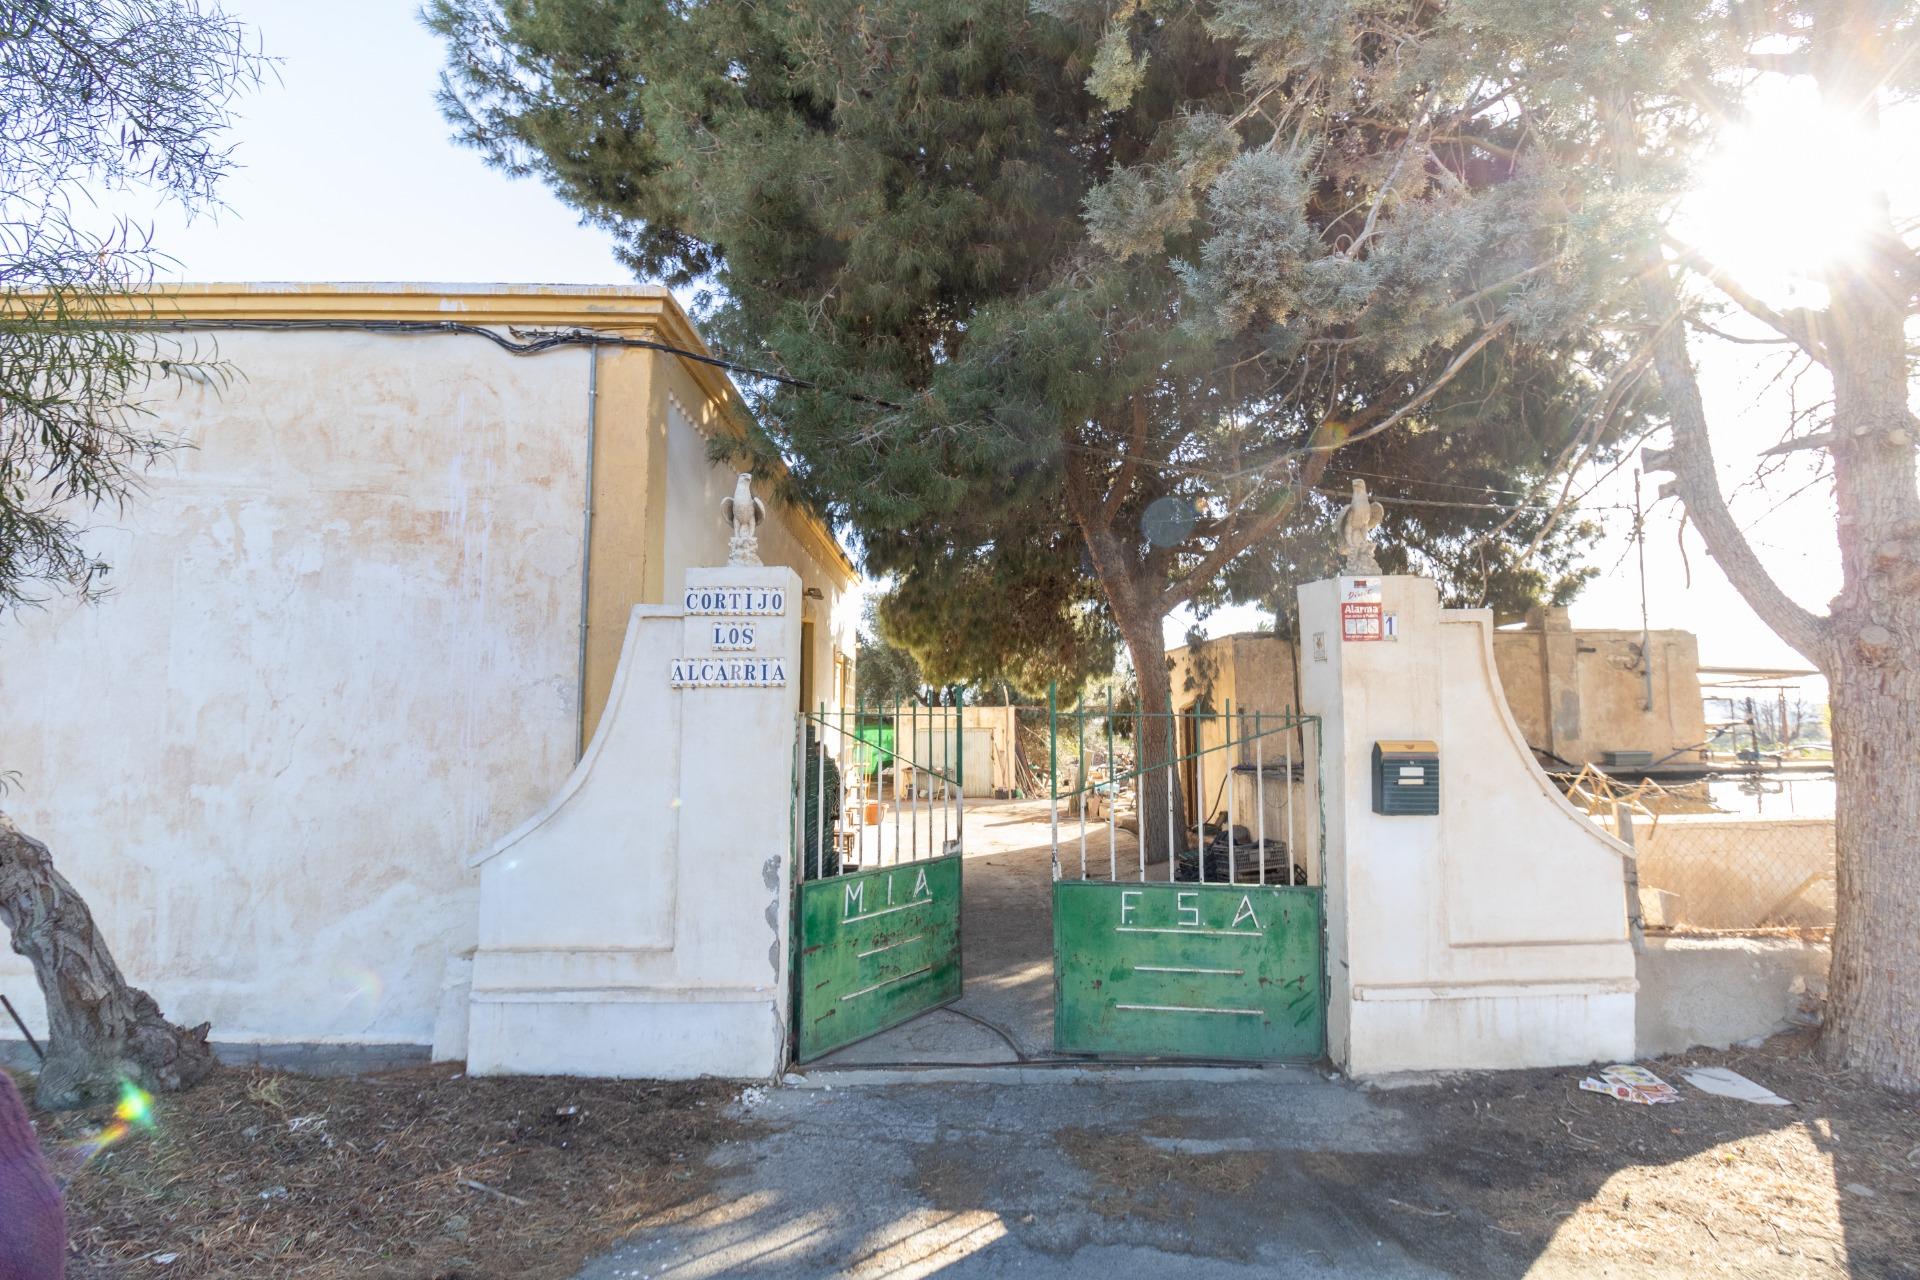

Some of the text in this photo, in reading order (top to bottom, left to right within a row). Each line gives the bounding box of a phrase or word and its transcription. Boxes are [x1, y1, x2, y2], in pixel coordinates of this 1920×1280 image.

[686, 593, 782, 610] CORTIJO
[1344, 604, 1379, 614] Alarma
[1385, 616, 1393, 635] 1
[714, 628, 754, 644] LOS
[671, 664, 785, 681] ALCARRIA
